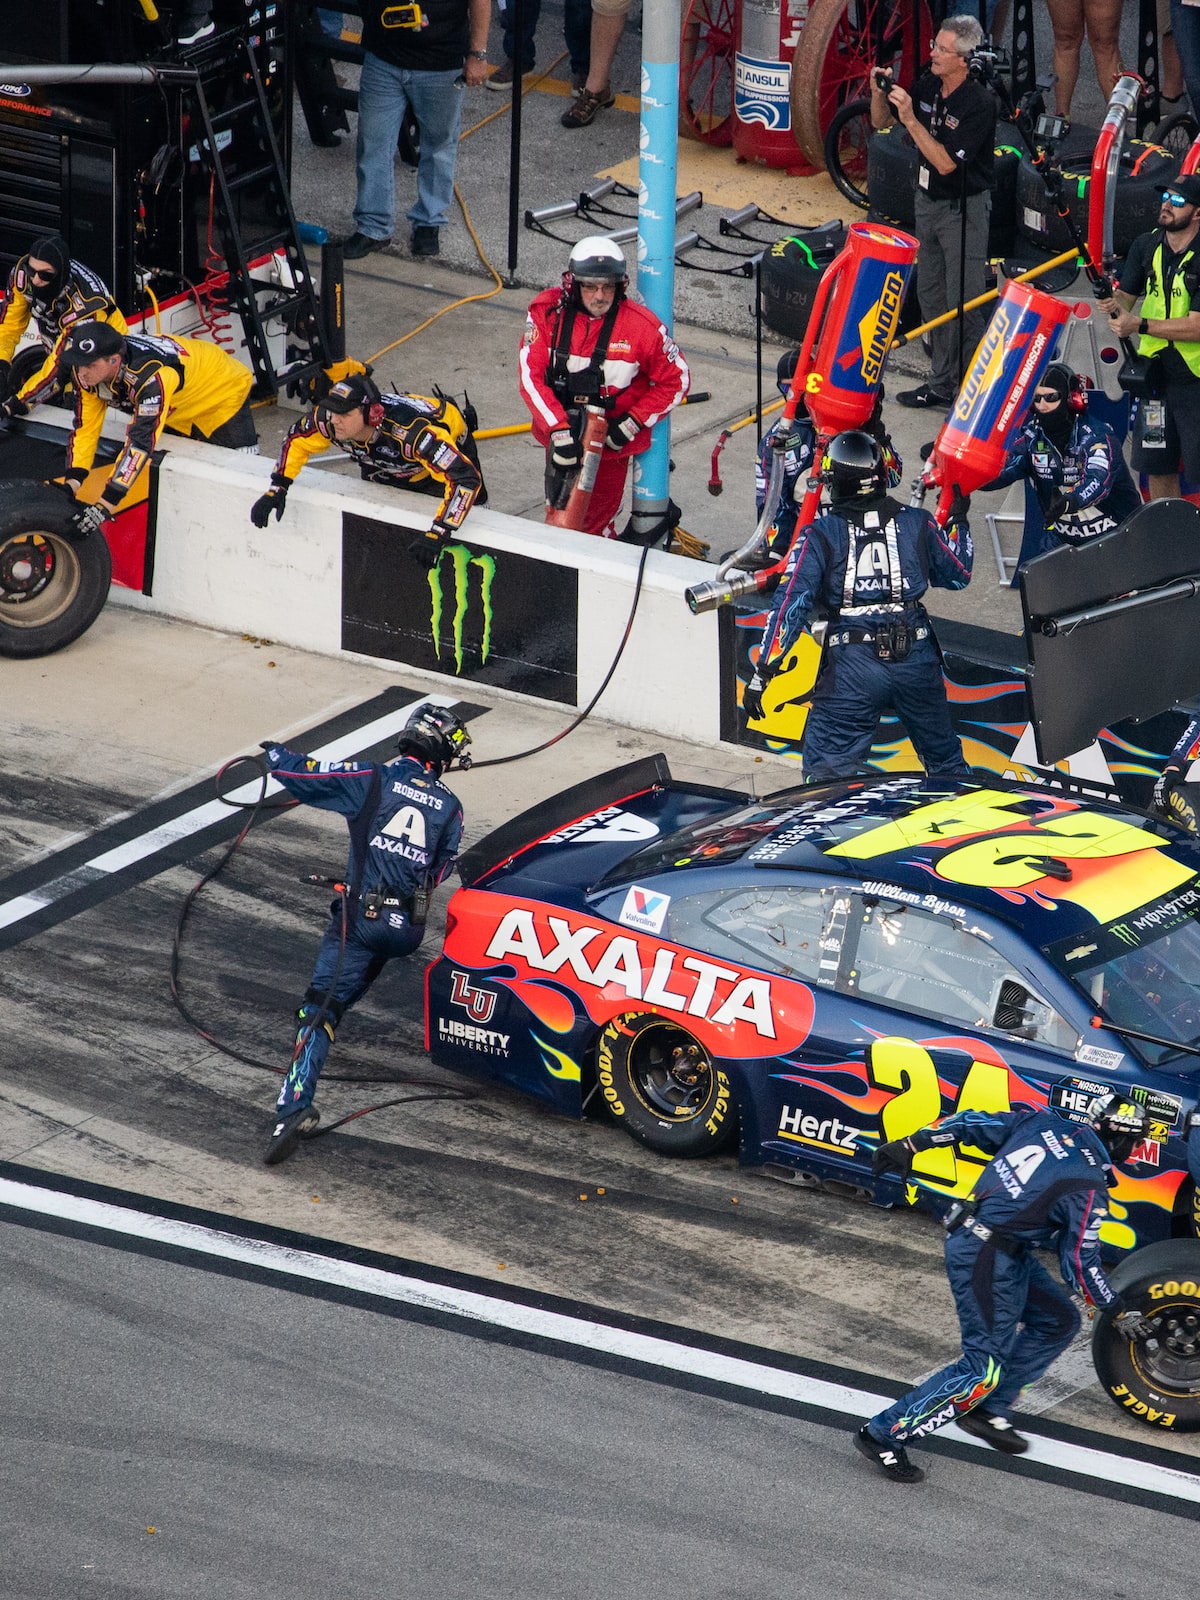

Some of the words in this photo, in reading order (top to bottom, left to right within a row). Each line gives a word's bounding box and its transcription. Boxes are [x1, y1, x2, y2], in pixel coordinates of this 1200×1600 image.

[745, 72, 784, 87] ANSUL
[864, 275, 903, 380] SUNOCO
[957, 311, 1009, 417] SUNOCO
[854, 577, 912, 592] AXALA
[392, 782, 443, 810] ROBERTS
[369, 835, 429, 865] AXALTA
[748, 825, 804, 860] SYSTEMS
[762, 825, 821, 860] COATING
[862, 881, 920, 904] William
[922, 894, 967, 918] Byron
[626, 912, 657, 928] Valvoline
[1163, 907, 1200, 930] ENERGY
[485, 908, 778, 1038] AXALTA
[439, 1017, 510, 1049] LIBERTY
[439, 1034, 510, 1058] UNIVERSITY
[1083, 1055, 1099, 1064] RACE
[1100, 1058, 1114, 1067] CAR
[1091, 1049, 1118, 1061] NASCAR
[705, 1070, 730, 1136] EAGLE
[1077, 1080, 1110, 1095] NASCAR
[1117, 1103, 1136, 1118] 24
[779, 1105, 860, 1150] Hertz
[993, 1159, 1025, 1200] AXALTA
[1089, 1266, 1115, 1304] AXALTA
[1111, 1383, 1177, 1427] EAGLE
[896, 1404, 955, 1441] AXALA
